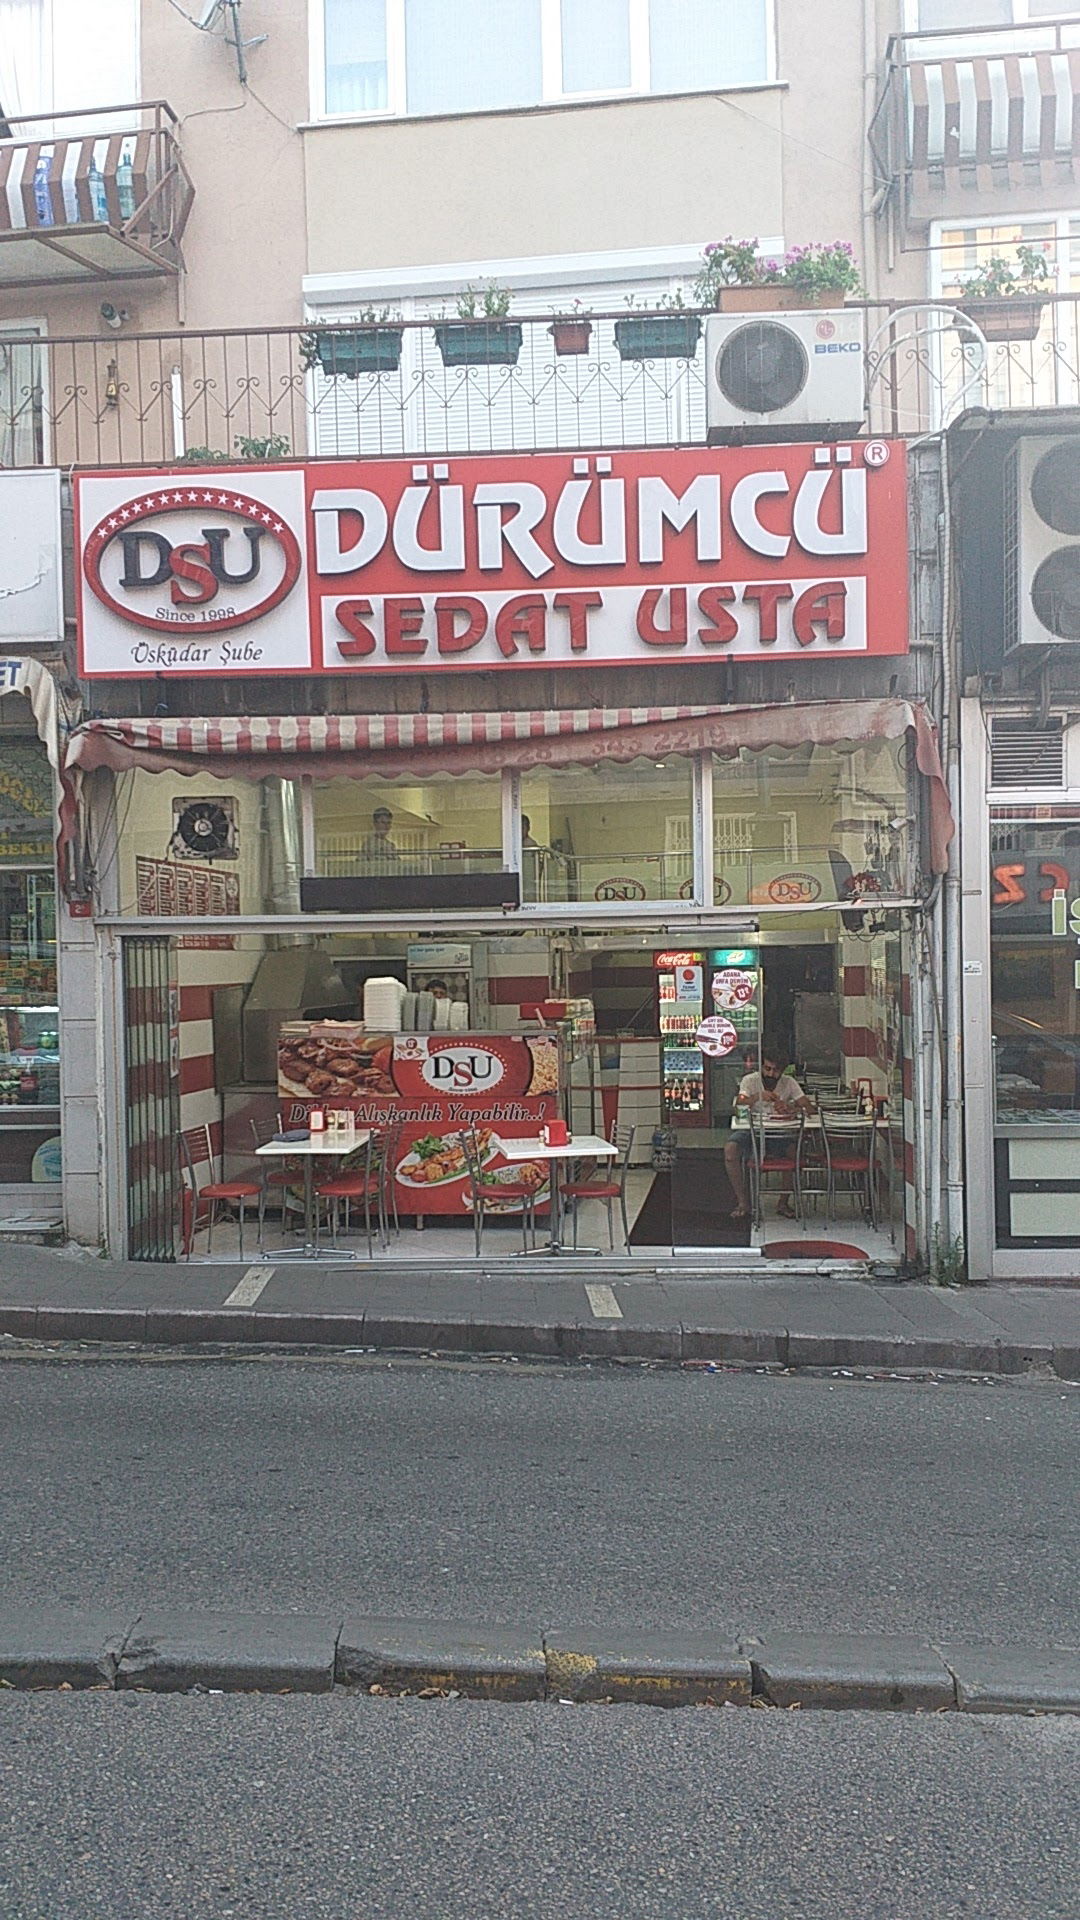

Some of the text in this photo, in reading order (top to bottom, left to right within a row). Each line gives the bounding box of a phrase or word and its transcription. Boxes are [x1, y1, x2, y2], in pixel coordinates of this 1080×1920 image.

[814, 342, 861, 354] BEKO
[311, 446, 868, 580] DÜRÜMCÜ
[116, 527, 266, 605] DSU
[155, 607, 236, 622] Since 1998
[335, 581, 847, 658] SEDAT USTA
[131, 641, 263, 667] Üsküdar Şube
[604, 887, 637, 900] DSU
[779, 882, 812, 900] DSU
[432, 1056, 493, 1087] DSU
[354, 1103, 442, 1125] Alışkanlık
